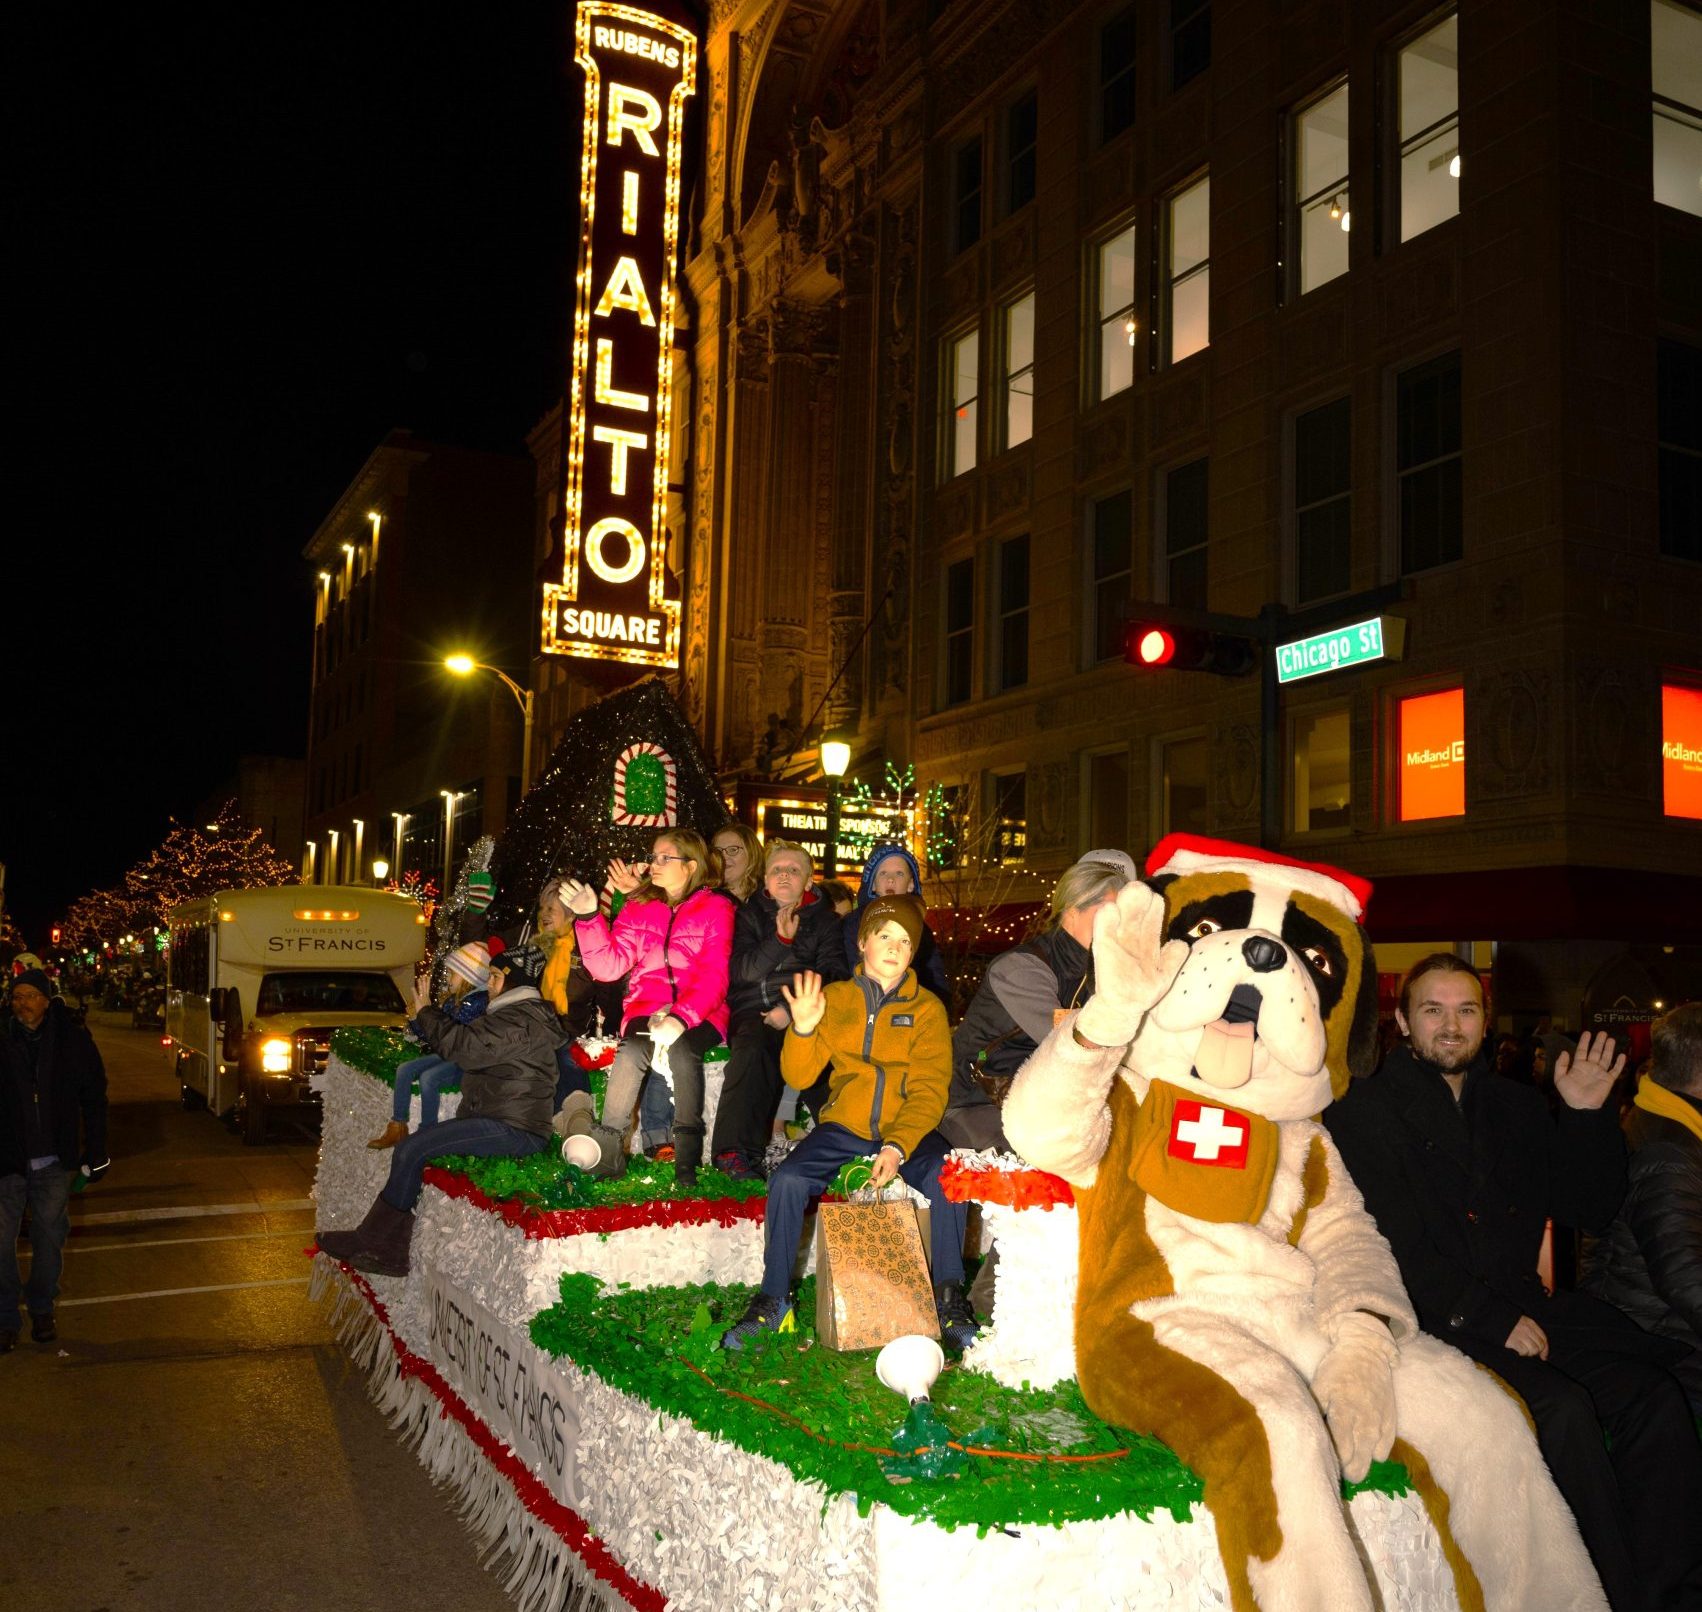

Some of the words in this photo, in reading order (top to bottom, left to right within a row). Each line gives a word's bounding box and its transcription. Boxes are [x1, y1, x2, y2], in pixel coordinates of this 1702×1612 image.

[594, 26, 679, 68] RUBENS
[585, 82, 662, 584] RIALTO
[563, 608, 660, 644] SQUARE
[1281, 636, 1351, 674] Chicago
[1358, 624, 1379, 653] St
[1407, 745, 1450, 765] Midland
[298, 937, 386, 952] FRANCIS
